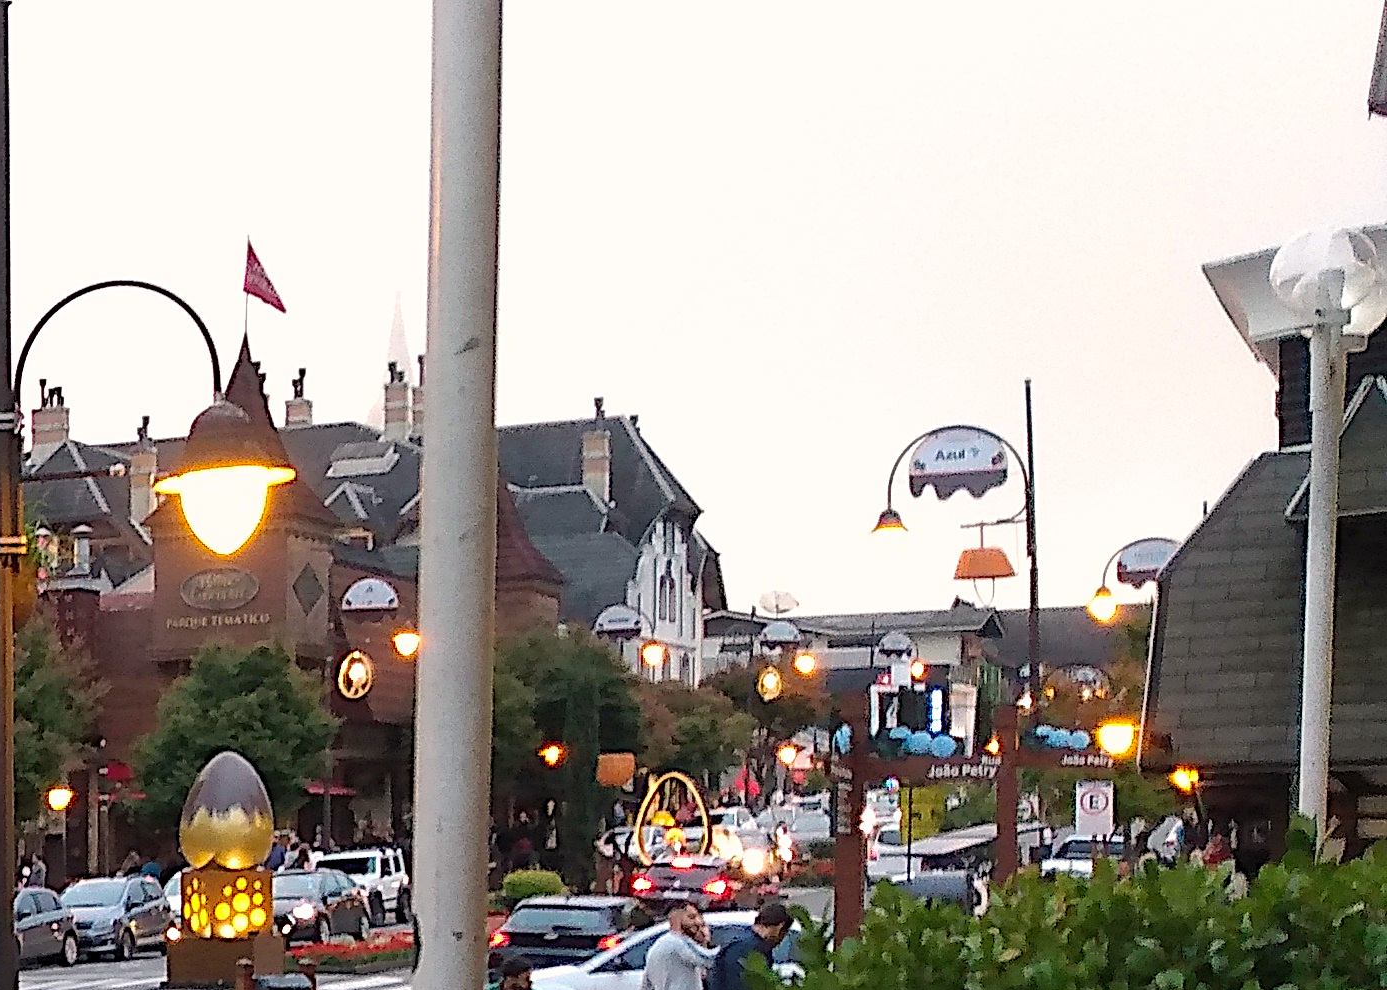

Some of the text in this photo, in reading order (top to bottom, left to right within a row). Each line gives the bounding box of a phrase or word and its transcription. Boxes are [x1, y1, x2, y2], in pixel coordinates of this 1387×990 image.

[935, 448, 966, 461] Azul
[927, 763, 998, 779] João Petry
